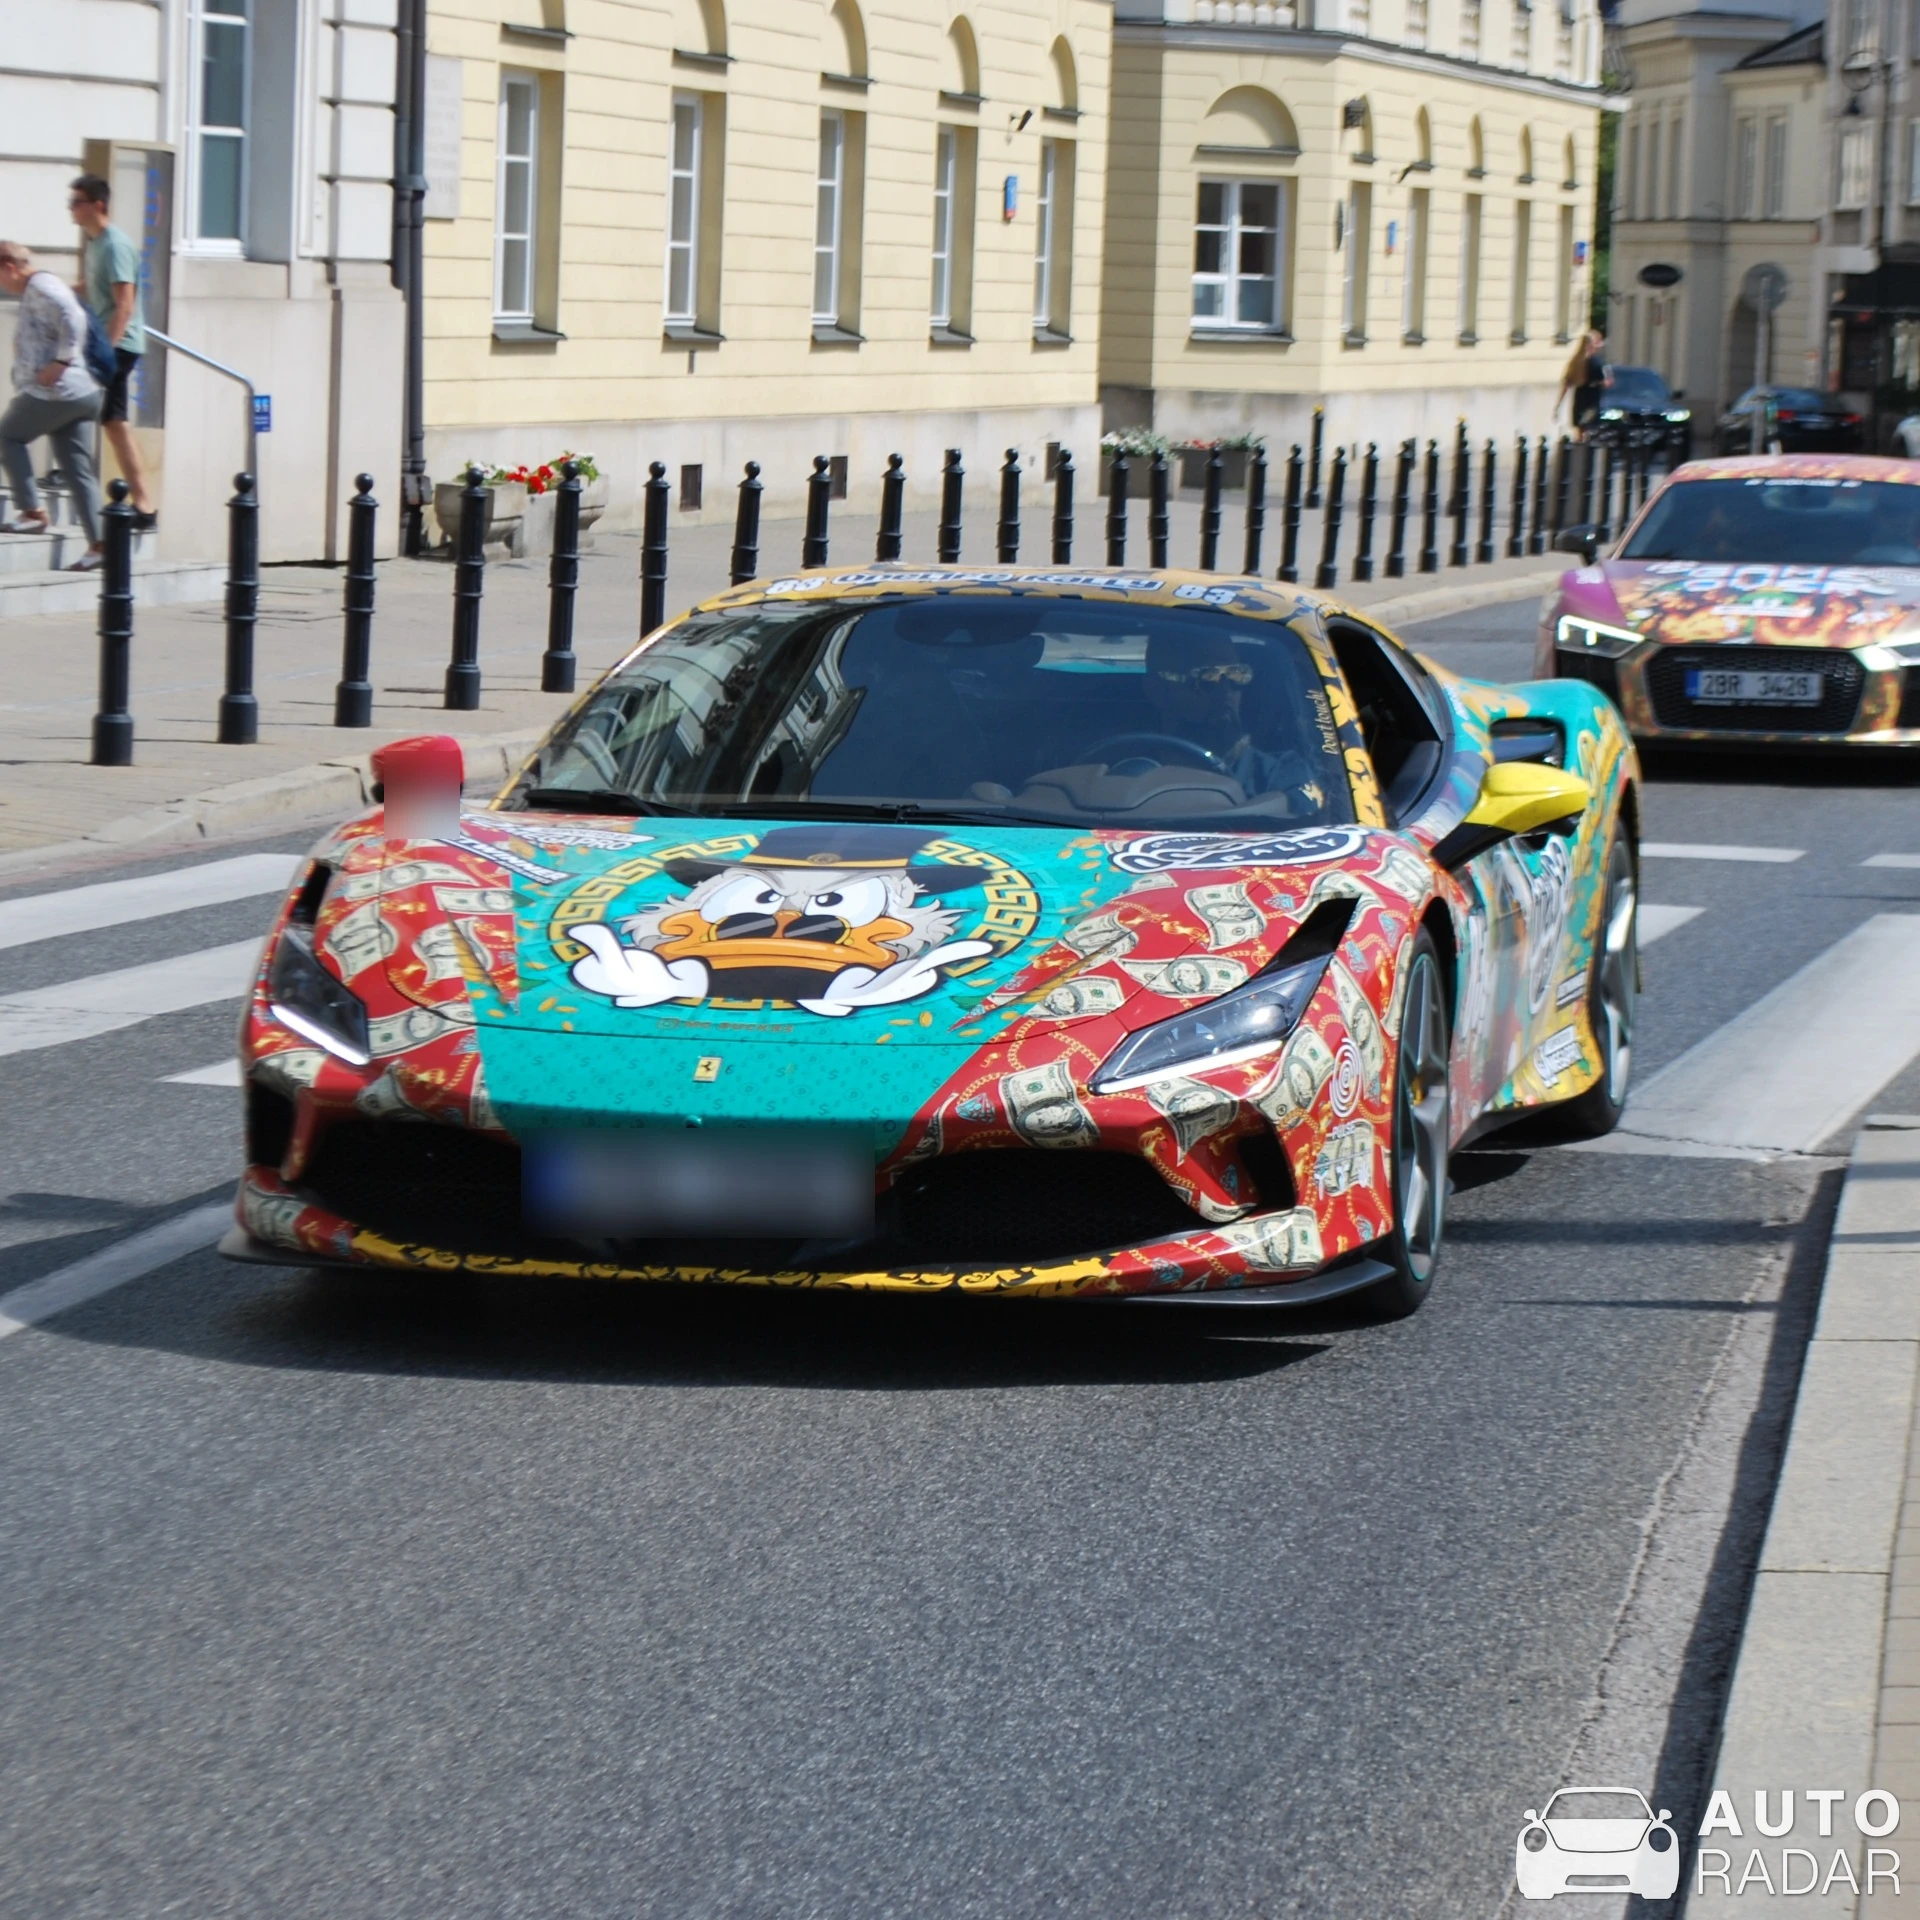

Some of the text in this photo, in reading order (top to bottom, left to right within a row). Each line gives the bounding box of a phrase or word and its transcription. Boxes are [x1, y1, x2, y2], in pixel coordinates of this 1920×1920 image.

[1174, 583, 1237, 604] 83
[1703, 674, 1740, 695] 2BR
[1220, 838, 1337, 862] RALLY
